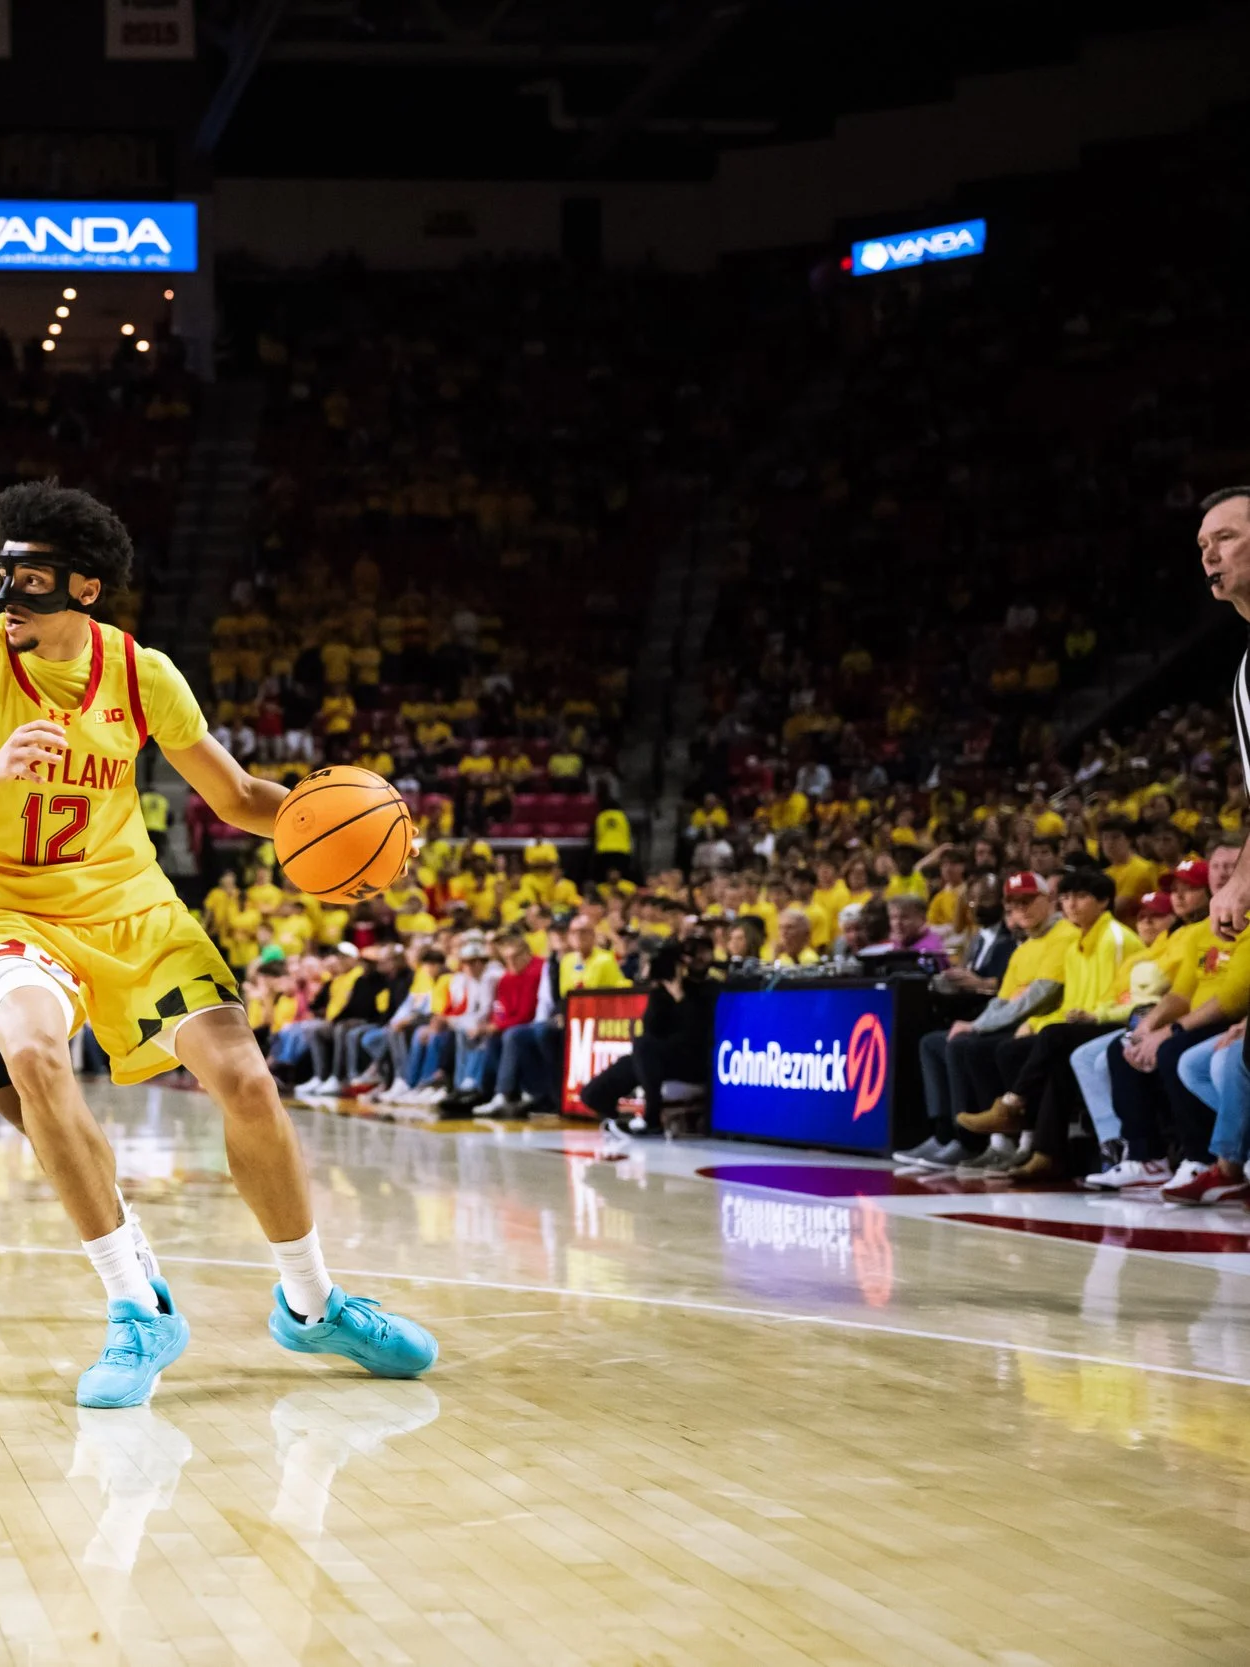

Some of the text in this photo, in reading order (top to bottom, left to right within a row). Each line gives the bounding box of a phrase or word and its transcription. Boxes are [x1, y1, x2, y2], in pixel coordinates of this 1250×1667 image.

[886, 228, 975, 262] VANDA
[21, 792, 91, 867] 12
[717, 1037, 847, 1092] CohnReznick
